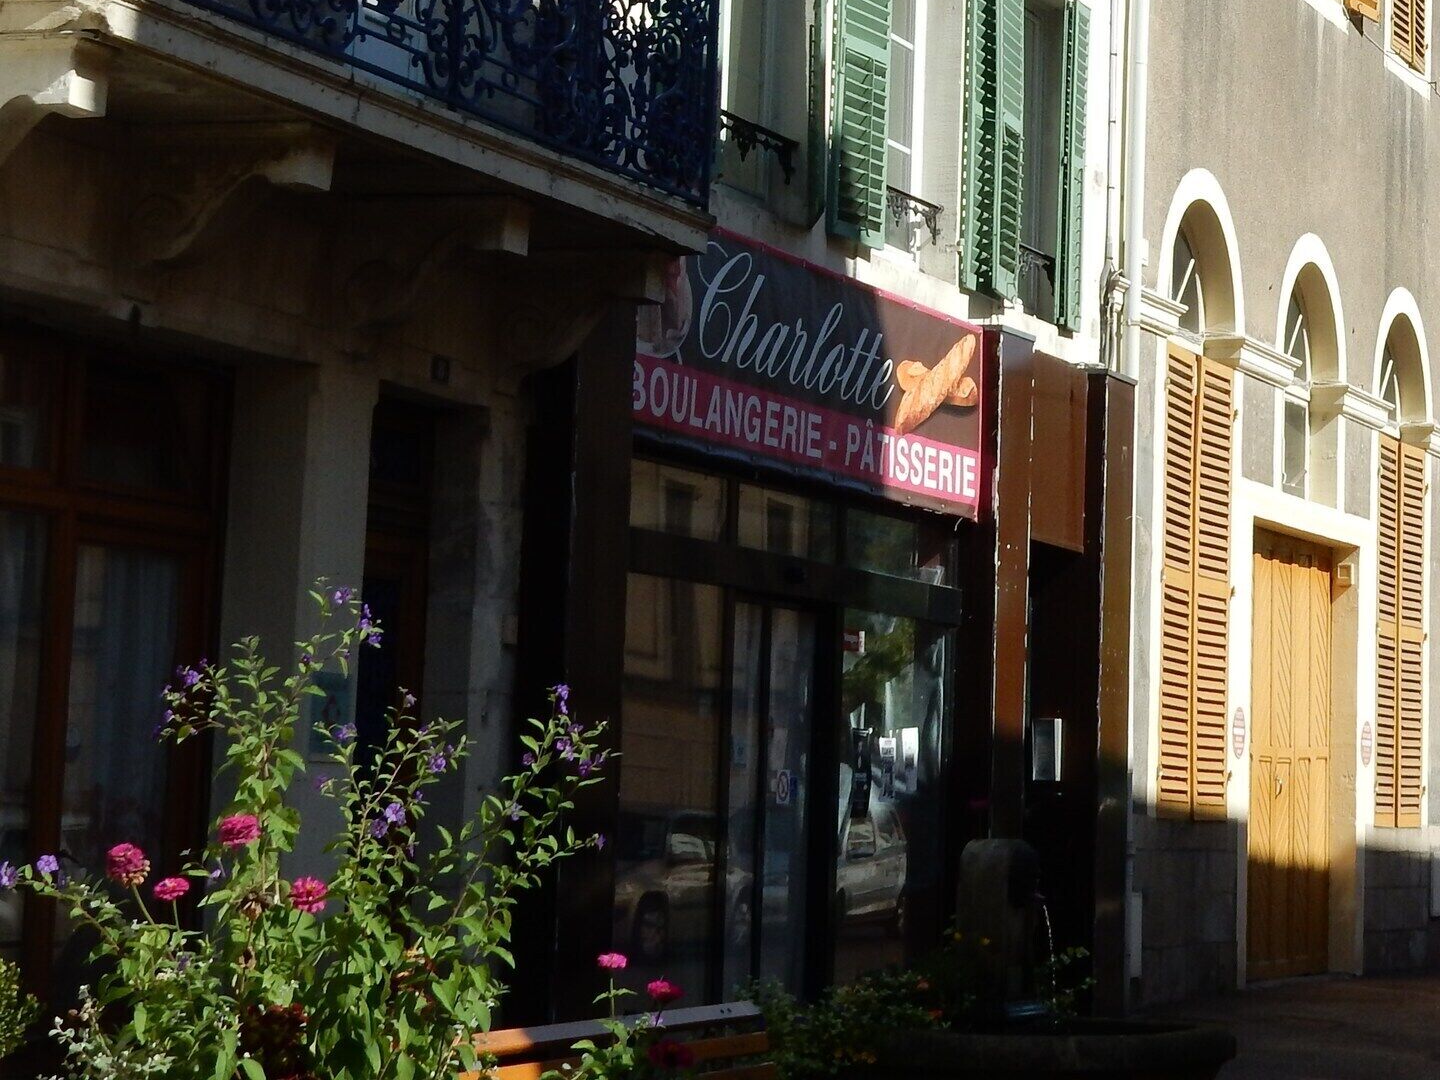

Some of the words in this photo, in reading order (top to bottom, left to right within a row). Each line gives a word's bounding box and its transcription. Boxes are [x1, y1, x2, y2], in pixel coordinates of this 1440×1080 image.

[697, 241, 894, 410] Charlotte
[633, 360, 823, 459] BOULANGERIE
[845, 418, 976, 498] PÂTISSERIE
